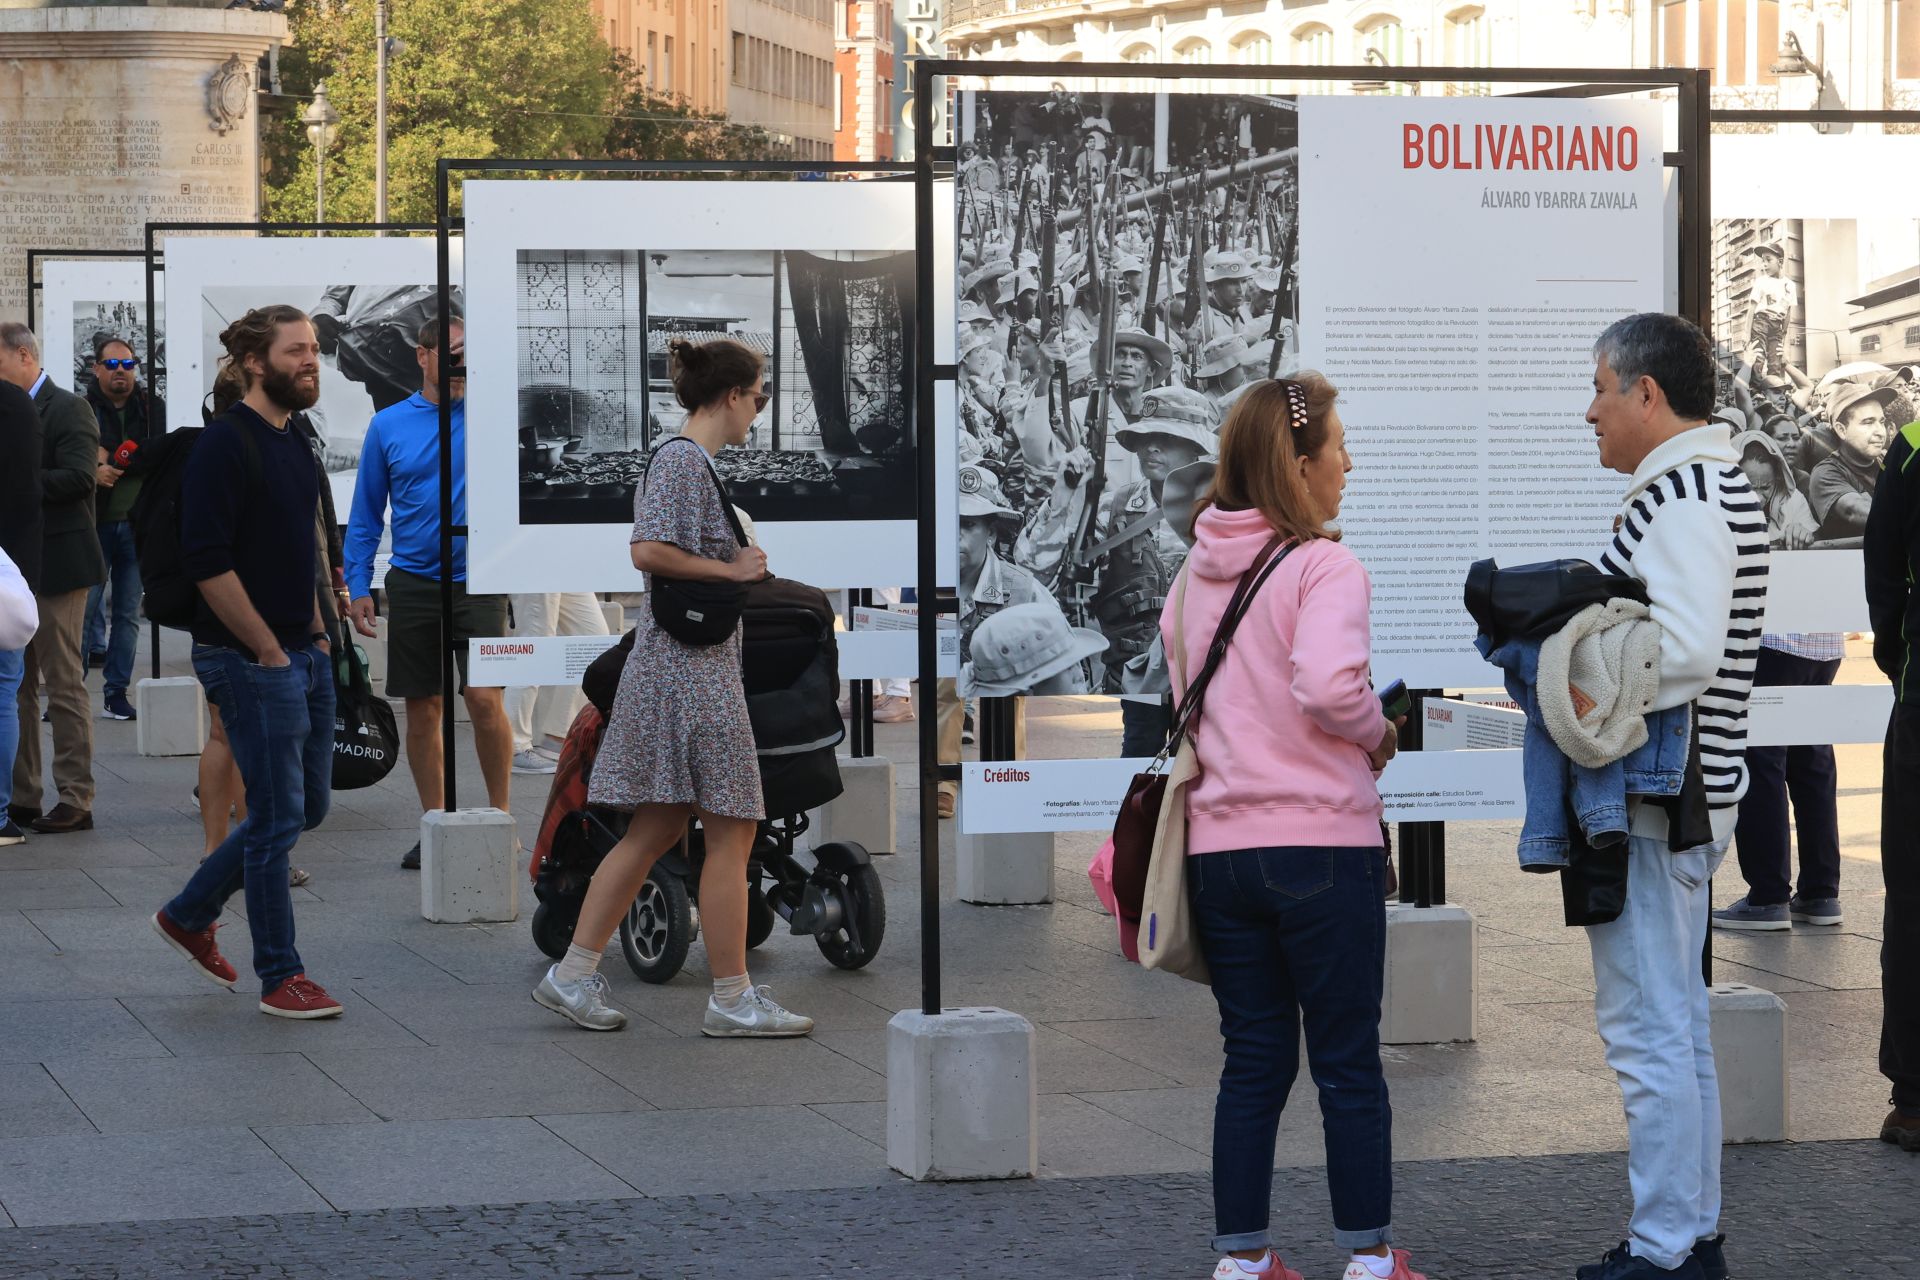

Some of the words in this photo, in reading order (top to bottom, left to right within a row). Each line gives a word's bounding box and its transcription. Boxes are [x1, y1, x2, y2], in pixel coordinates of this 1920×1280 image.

[196, 144, 231, 154] CARLOS
[1403, 123, 1638, 171] BOLIVARIANO
[192, 157, 204, 165] REY
[210, 157, 219, 165] DE
[66, 195, 104, 203] SVCEDIO
[110, 195, 116, 203] A
[121, 195, 131, 203] SV
[1481, 187, 1530, 208] ÁLVARO
[1535, 191, 1586, 209] YBARRA
[1591, 191, 1637, 210] ZAVALA
[14, 205, 73, 213] PENSADORES
[145, 205, 150, 213] Y
[160, 205, 201, 213] ARTISTAS
[6, 216, 15, 224] EL
[20, 216, 61, 224] FOMENTO
[67, 216, 76, 224] DE
[6, 237, 18, 246] LA
[26, 237, 73, 246] ACTIVIDAD
[79, 237, 88, 246] DE
[1332, 306, 1356, 314] proyecto
[1342, 319, 1377, 327] impresionante
[1464, 345, 1478, 353] Hugo
[1420, 450, 1434, 458] Hugo
[1436, 463, 1454, 471] pueblo
[480, 644, 533, 655] BOLIVARIANO
[333, 741, 384, 760] MADRID
[984, 768, 1030, 782] Créditos
